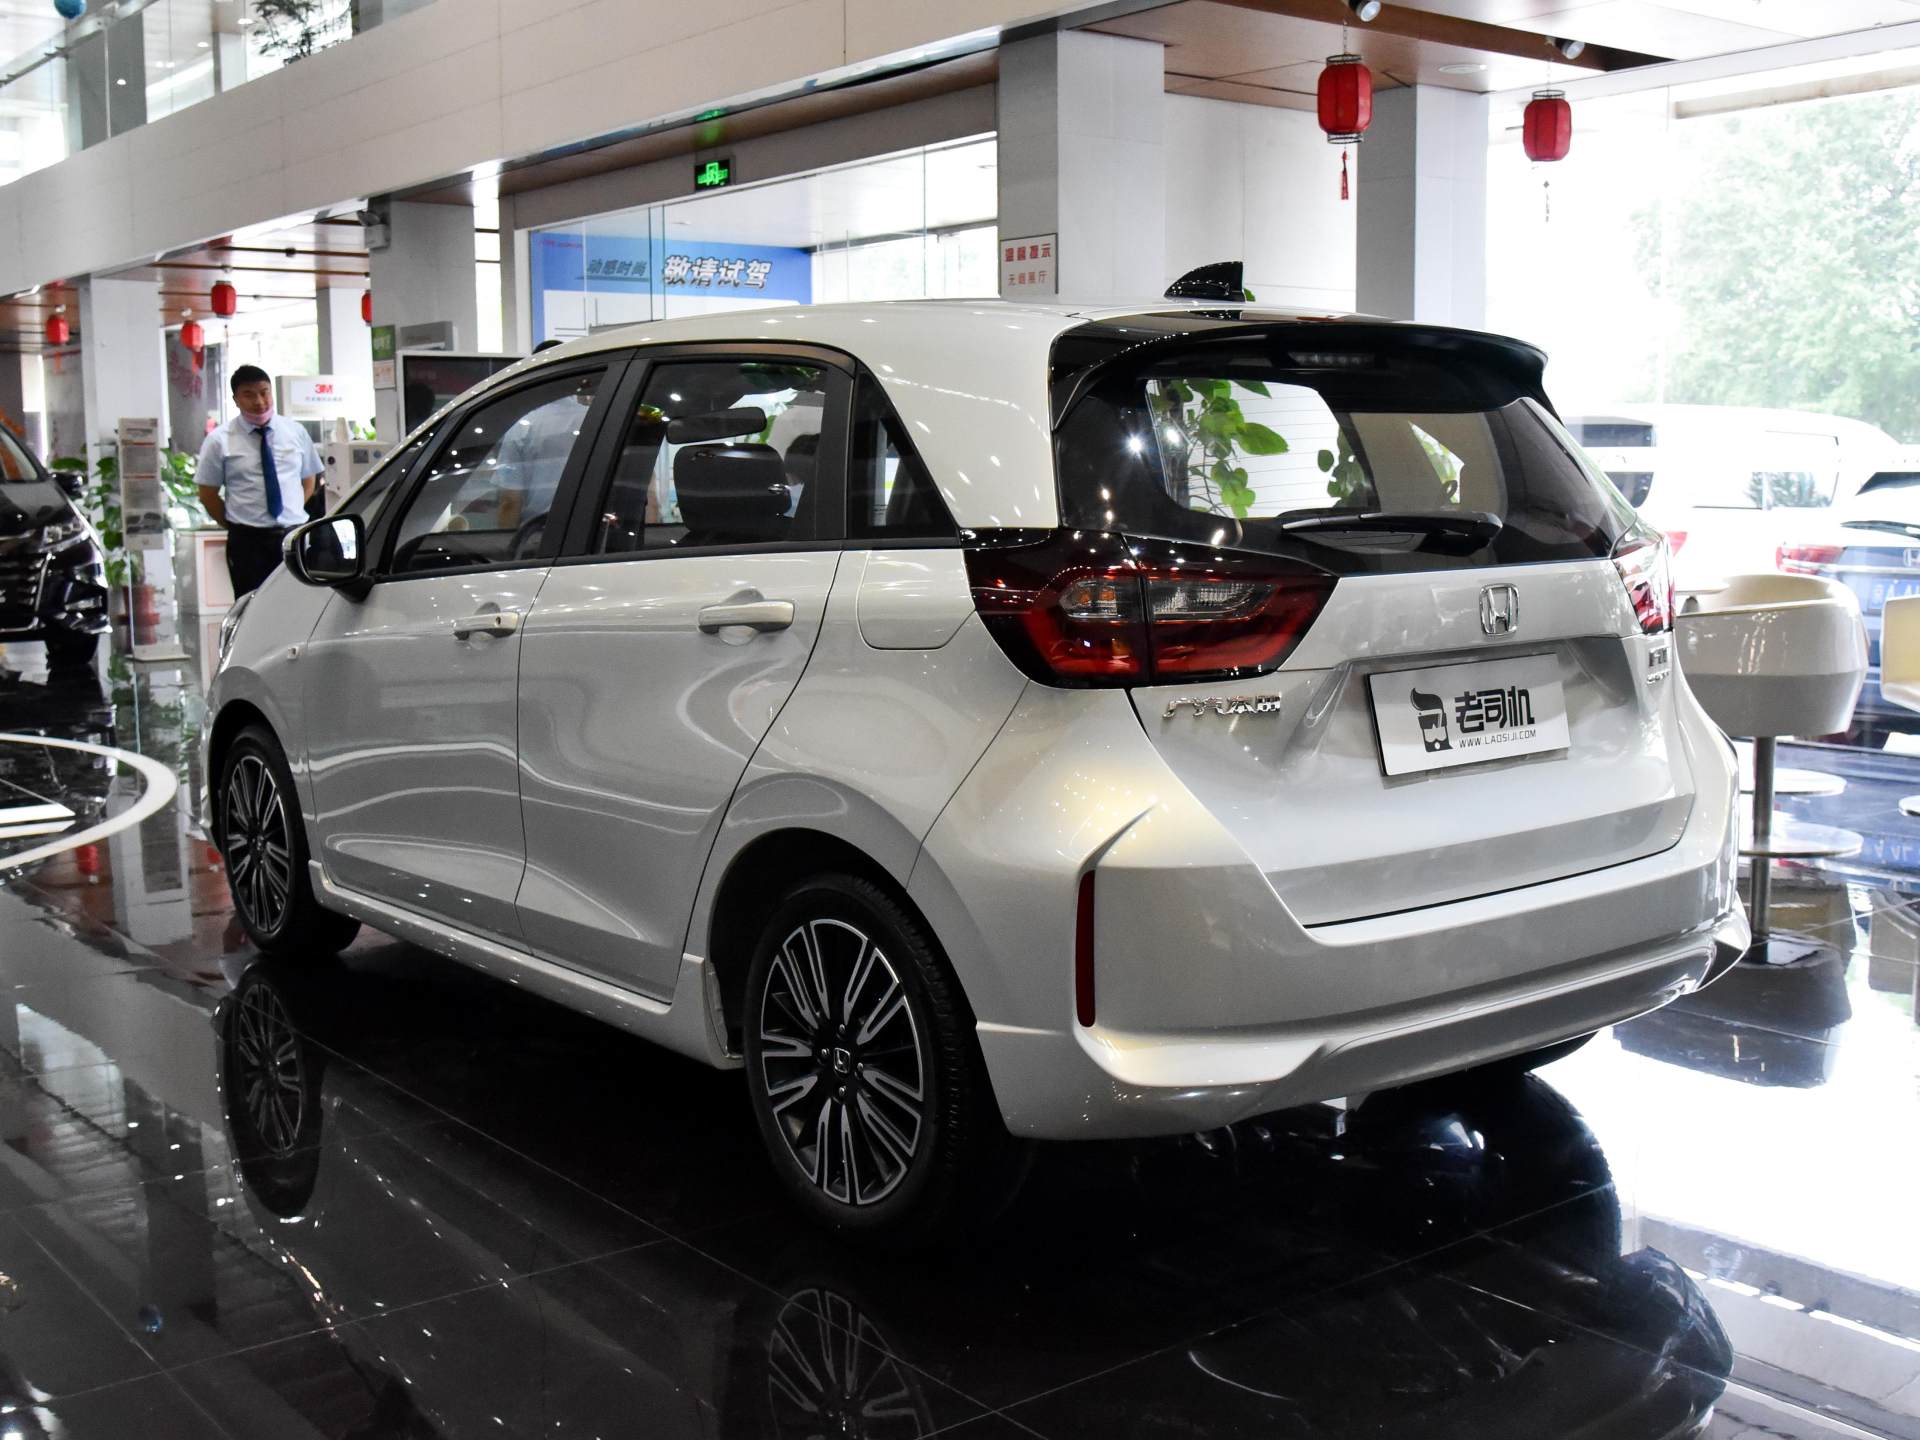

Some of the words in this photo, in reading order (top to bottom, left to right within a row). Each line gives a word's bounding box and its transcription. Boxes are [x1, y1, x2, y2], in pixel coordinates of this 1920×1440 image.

[586, 257, 648, 278] 动感时尚
[664, 254, 772, 290] 敬请试驾
[314, 383, 334, 394] 3M
[1162, 692, 1281, 718] 广汽本田
[1455, 685, 1535, 734] 老司机
[1459, 729, 1537, 749] WWW.LAOSIJI.COM
